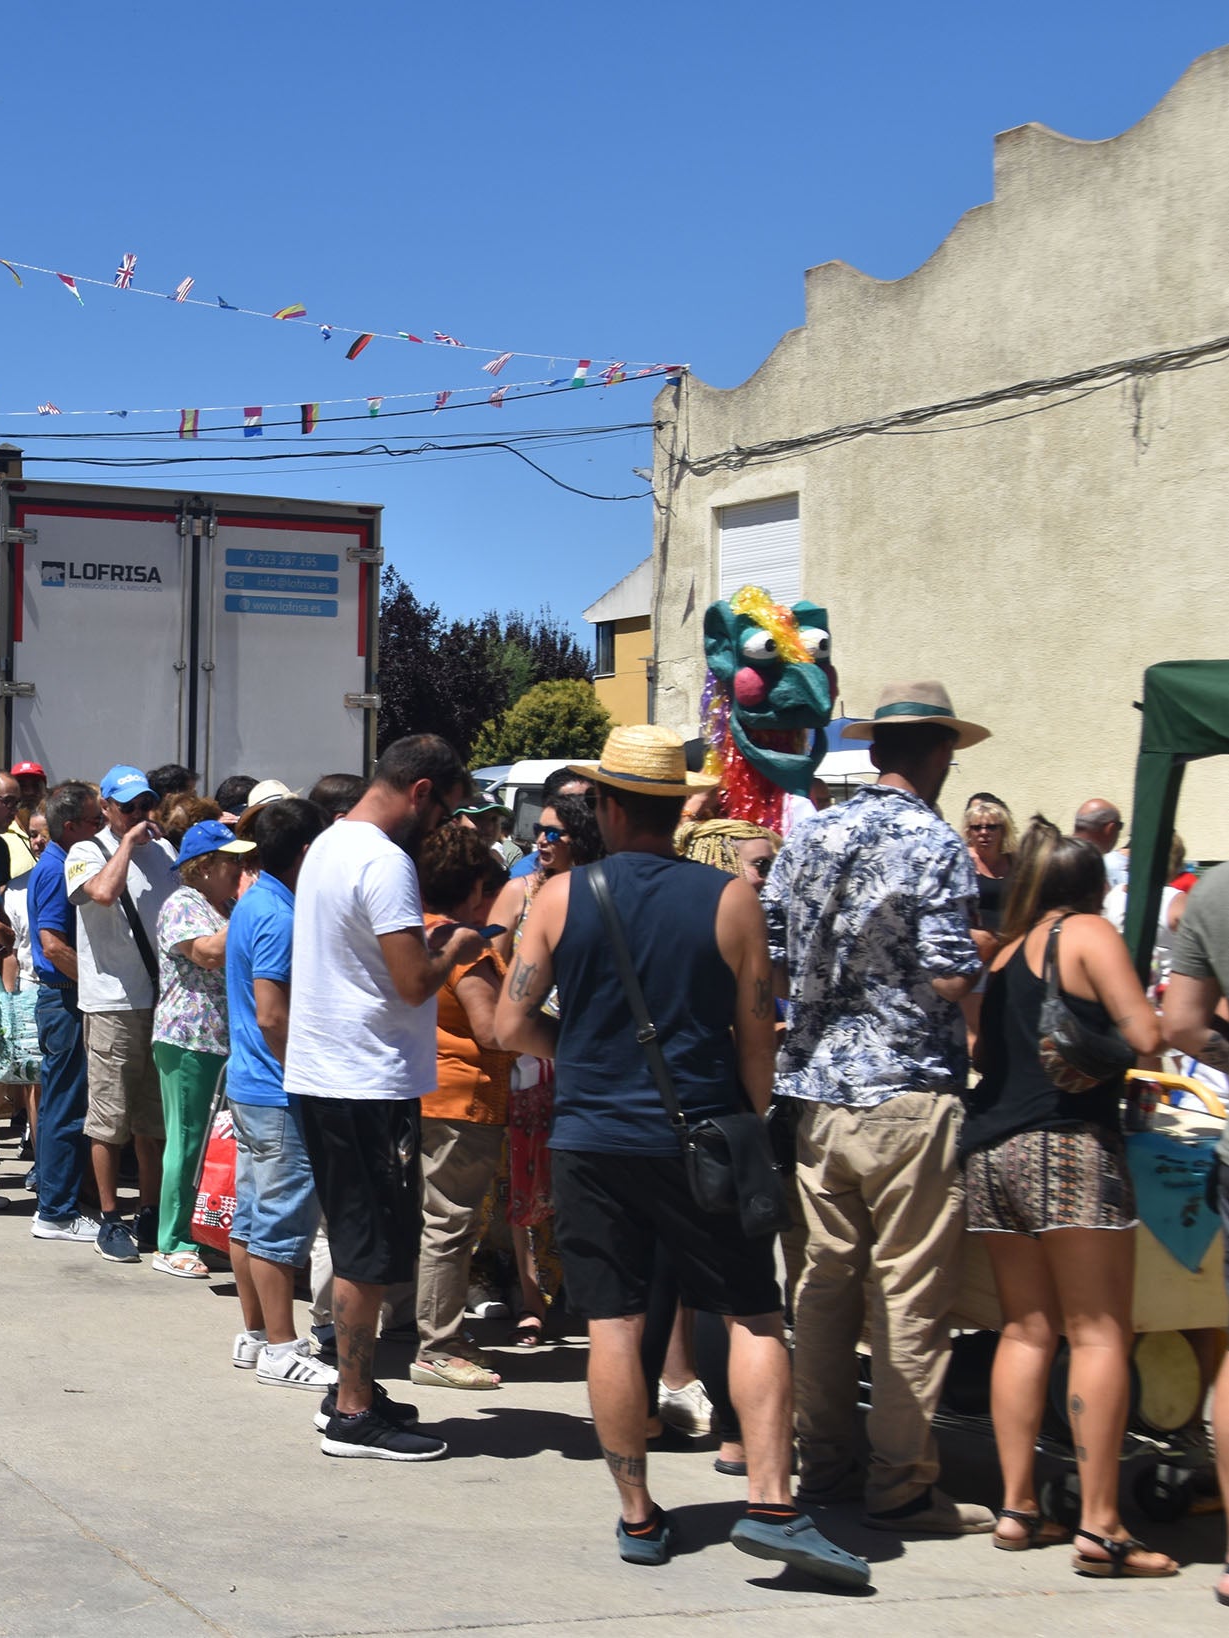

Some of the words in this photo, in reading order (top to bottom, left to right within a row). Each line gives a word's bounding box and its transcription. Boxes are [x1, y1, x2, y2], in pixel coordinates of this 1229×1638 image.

[258, 554, 276, 565] 923
[69, 562, 162, 583] LOFRISA
[252, 600, 322, 613] www.lofrisa.es
